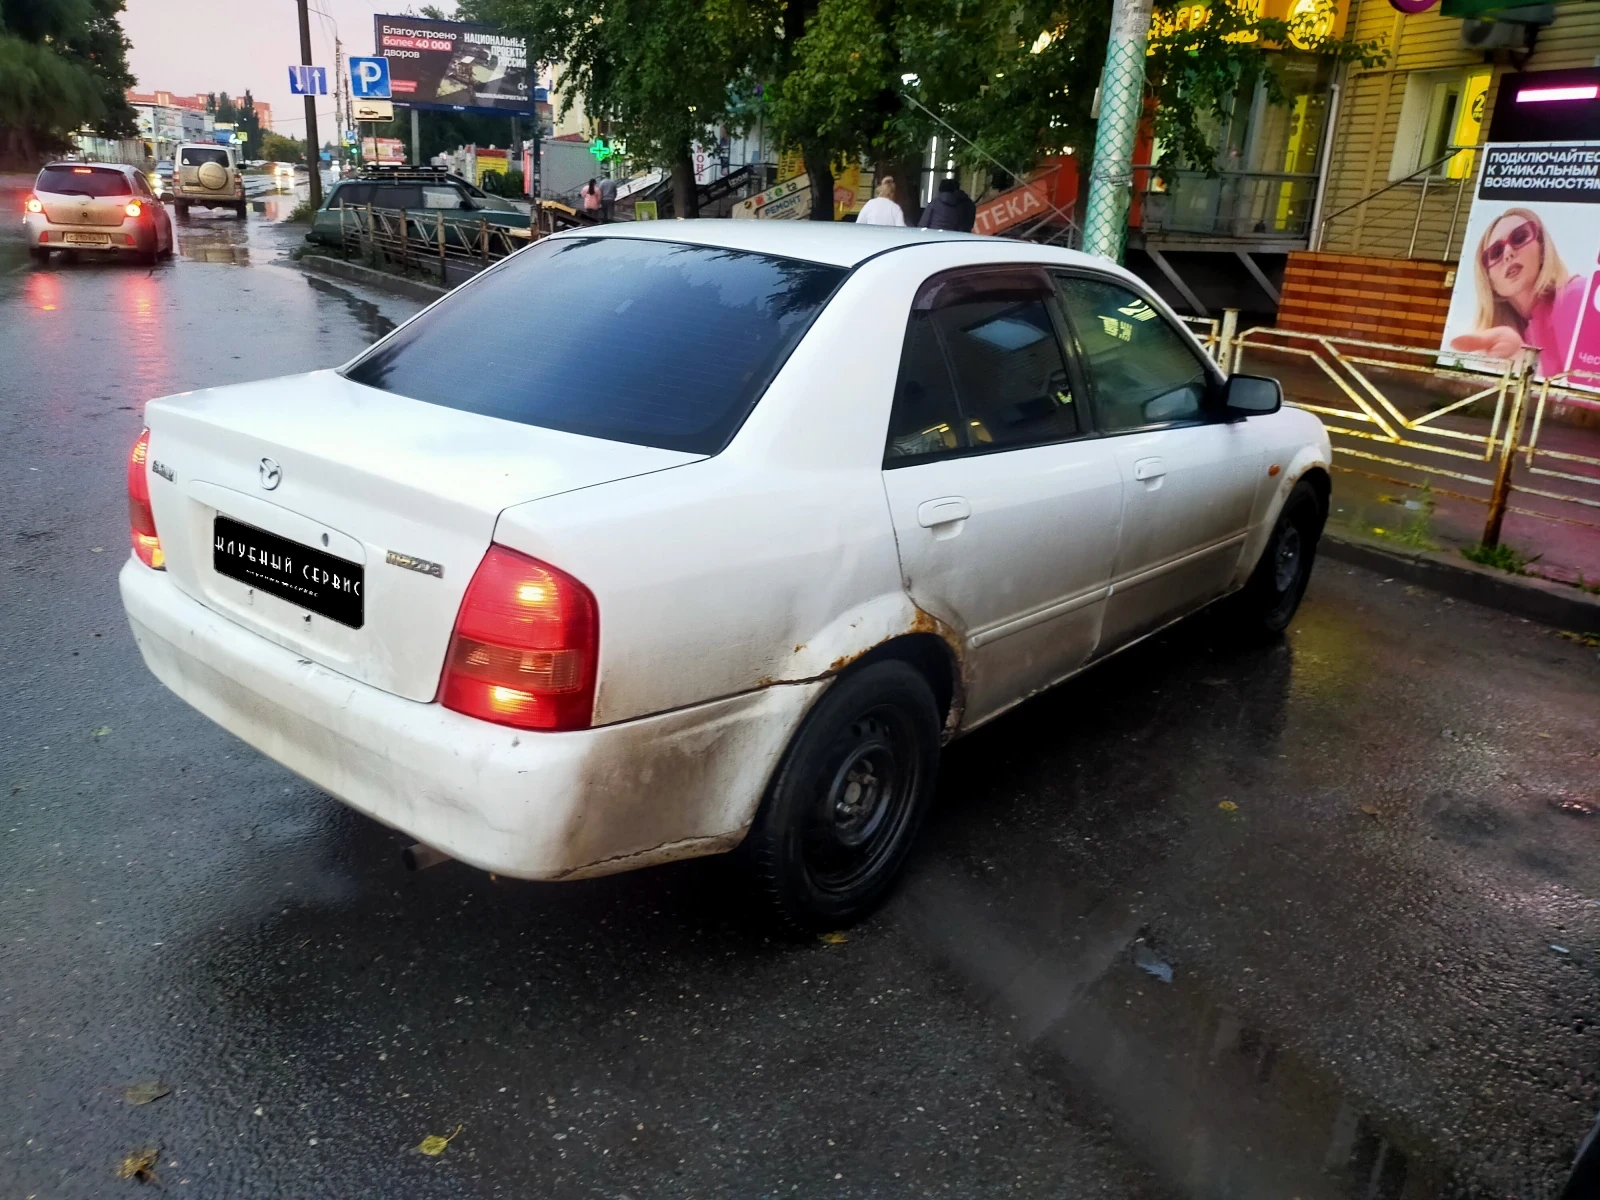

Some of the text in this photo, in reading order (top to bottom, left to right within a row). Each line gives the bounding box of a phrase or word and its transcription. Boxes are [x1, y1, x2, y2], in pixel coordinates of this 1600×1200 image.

[383, 26, 457, 41] Благоустроено
[464, 32, 526, 48] НАЦИОНАЛЬНЫЕ
[383, 37, 451, 50] более 40 000
[383, 48, 420, 59] дворов
[491, 45, 526, 58] ПРОЕКТЫ
[498, 56, 526, 68] РОССИИ
[359, 61, 382, 92] P
[1474, 94, 1485, 111] 2
[1489, 148, 1600, 165] ПОДКЛЮЧАЙТЕС
[1487, 165, 1598, 176] К УНИКАЛЬНЫМ
[764, 195, 802, 216] РЕМОНТ
[974, 191, 1040, 234] ТЕКА
[1578, 351, 1600, 366] Чес
